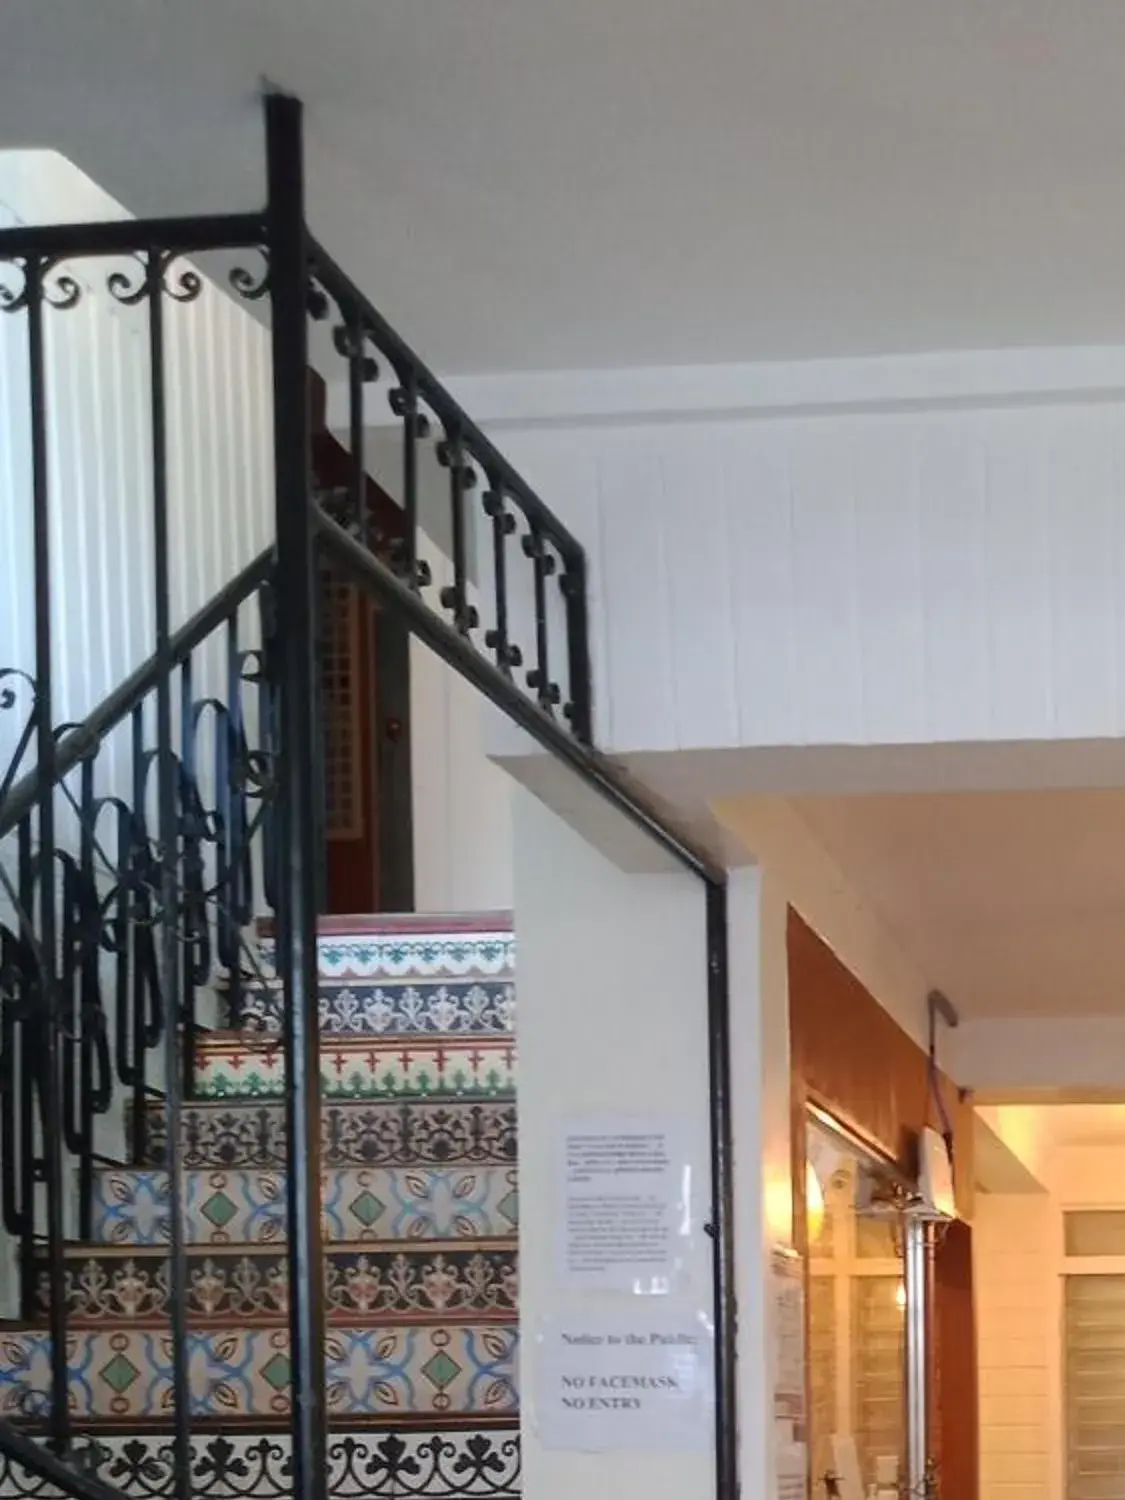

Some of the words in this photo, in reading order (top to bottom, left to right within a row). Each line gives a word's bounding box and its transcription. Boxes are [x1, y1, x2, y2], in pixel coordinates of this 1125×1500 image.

[607, 1335, 622, 1345] to
[625, 1333, 646, 1345] the
[561, 1375, 585, 1389] NO
[561, 1397, 585, 1410] NO
[588, 1397, 642, 1410] ENTRY
